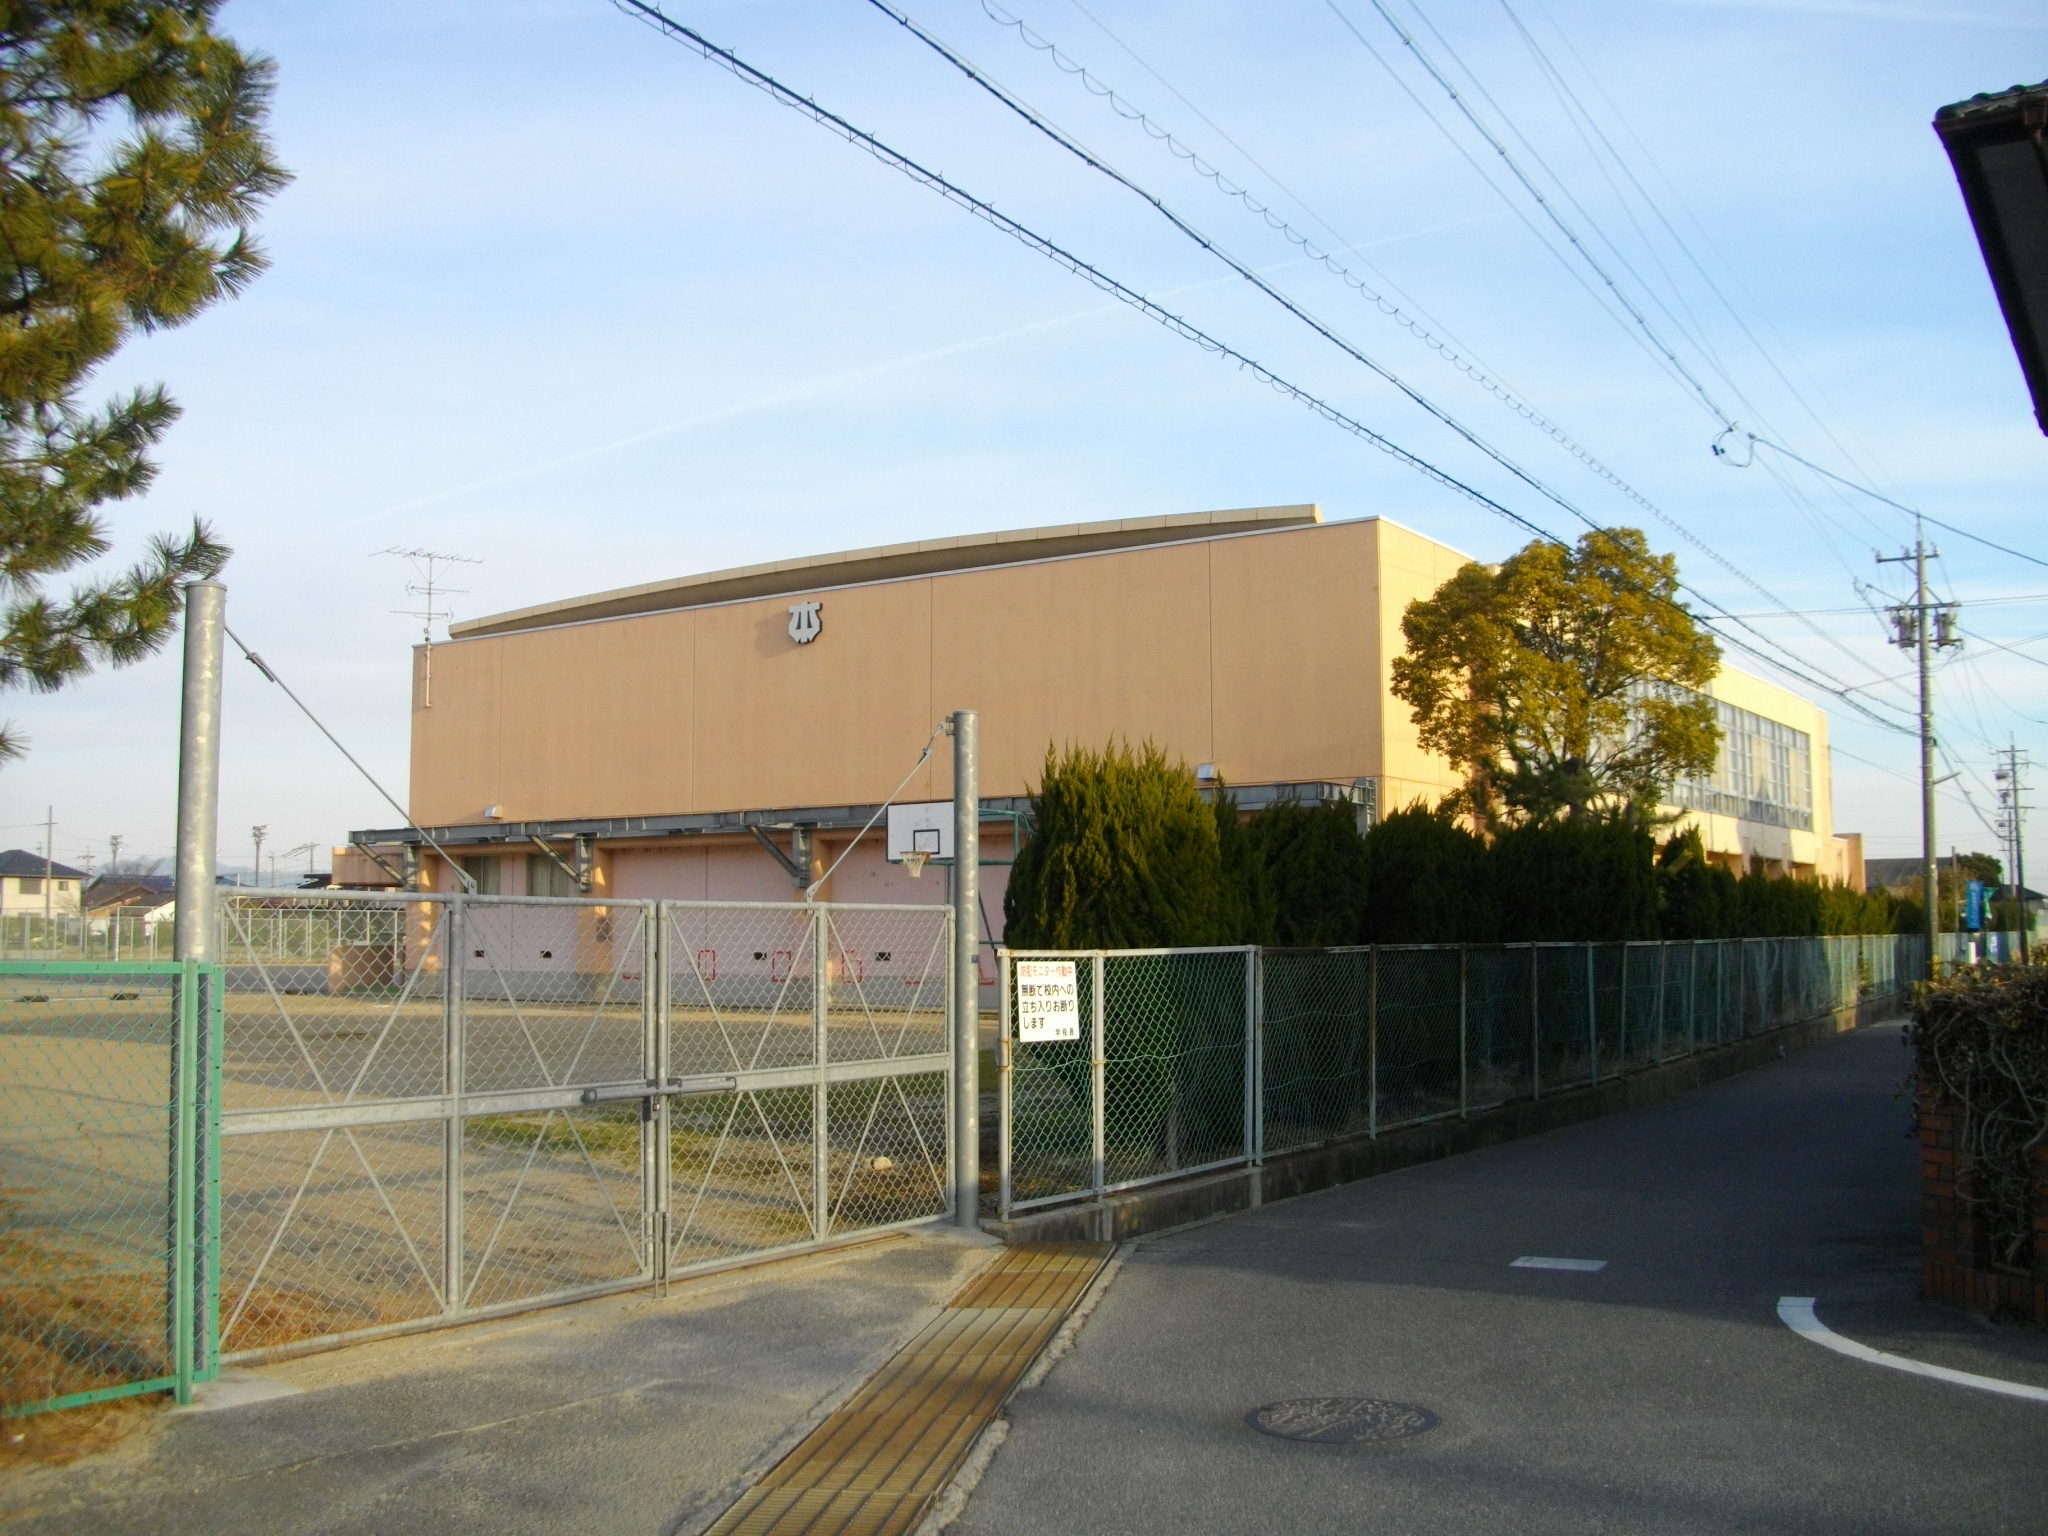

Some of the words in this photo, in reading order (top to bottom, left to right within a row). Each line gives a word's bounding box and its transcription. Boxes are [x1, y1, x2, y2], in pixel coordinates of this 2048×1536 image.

[1021, 984, 1074, 997] 無断で校内への
[1022, 1000, 1075, 1014] 立ち入りお断り
[1023, 1017, 1045, 1029] します
